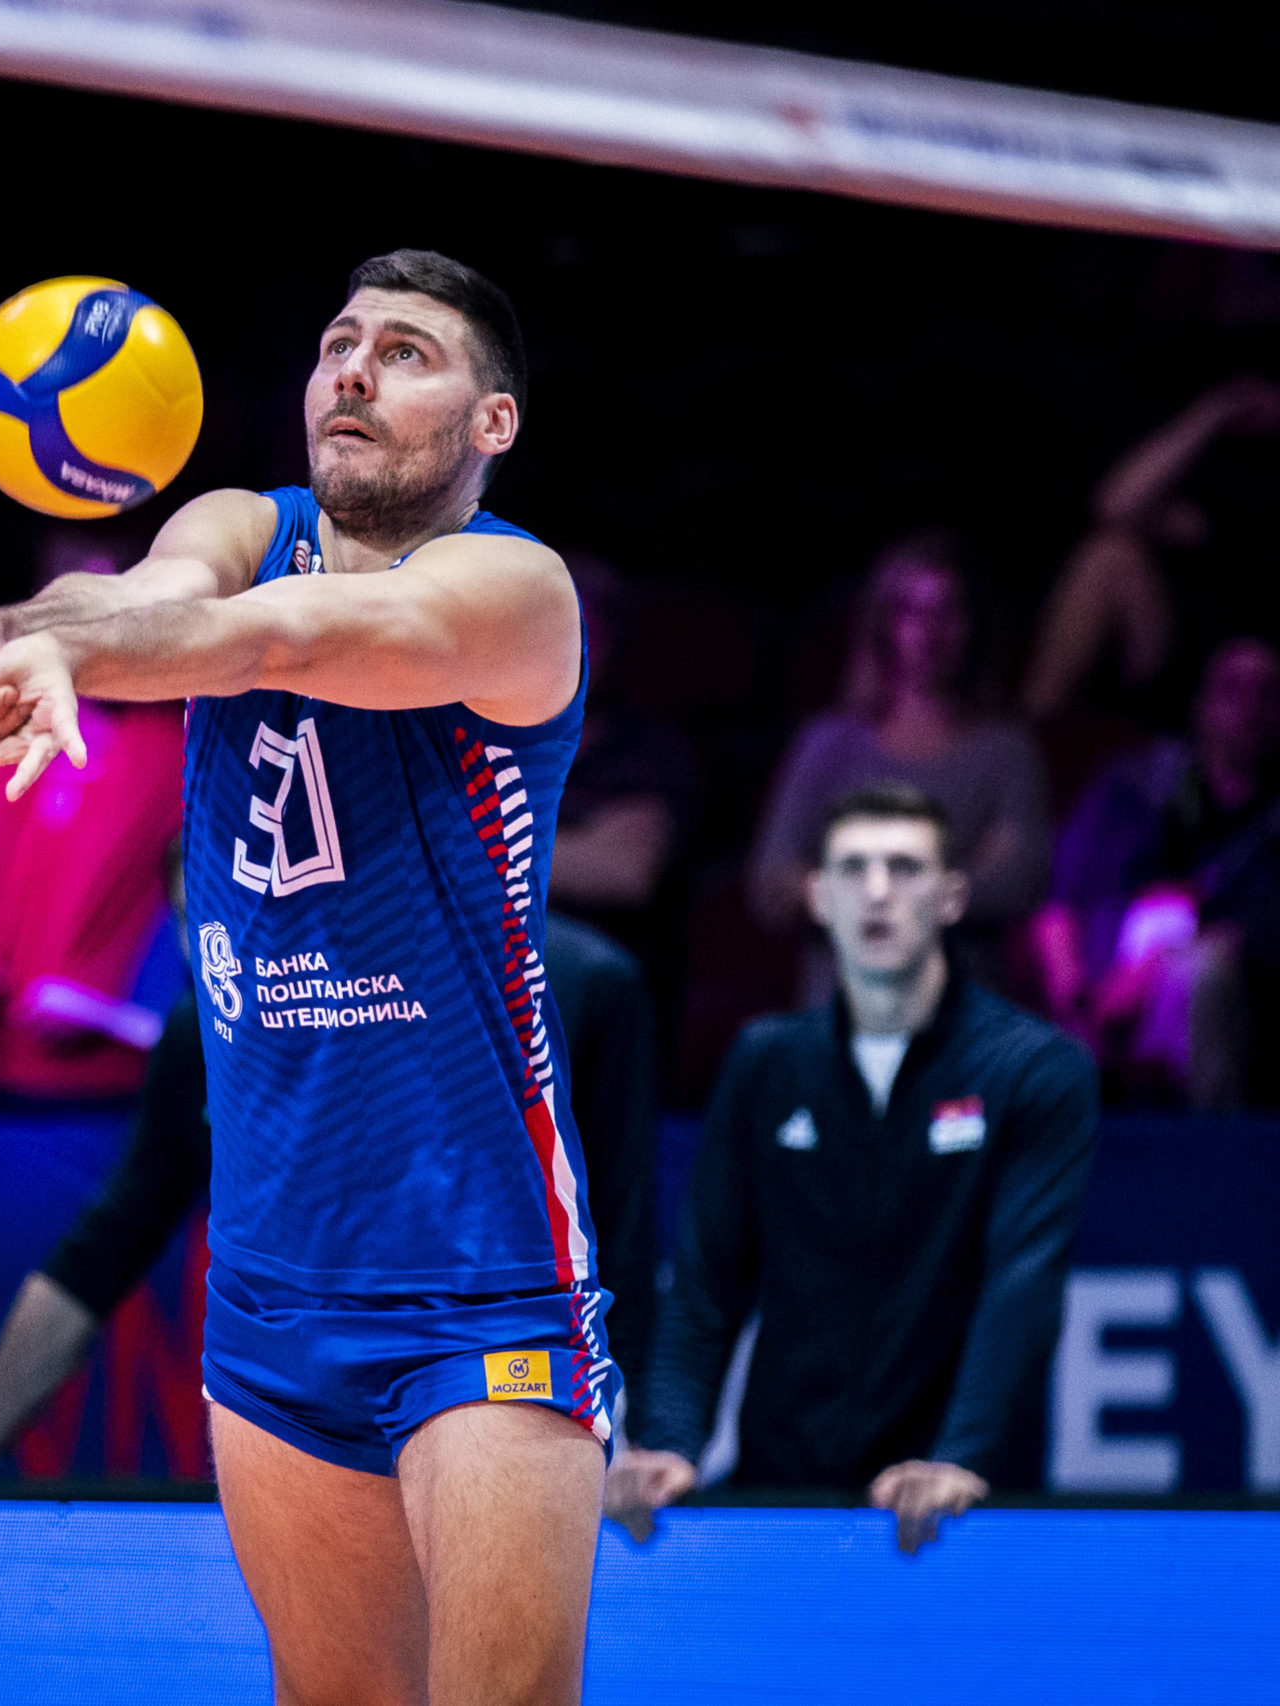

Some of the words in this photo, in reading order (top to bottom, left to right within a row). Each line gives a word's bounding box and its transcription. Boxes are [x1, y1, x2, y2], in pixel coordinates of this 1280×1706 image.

[232, 717, 346, 897] 30
[255, 952, 329, 978] БАНКА
[257, 974, 404, 1004] ПОШТАНСКА
[260, 1001, 427, 1029] ШТЕДИОНИЦА
[214, 1016, 233, 1043] 1921
[492, 1382, 547, 1394] MOZZART
